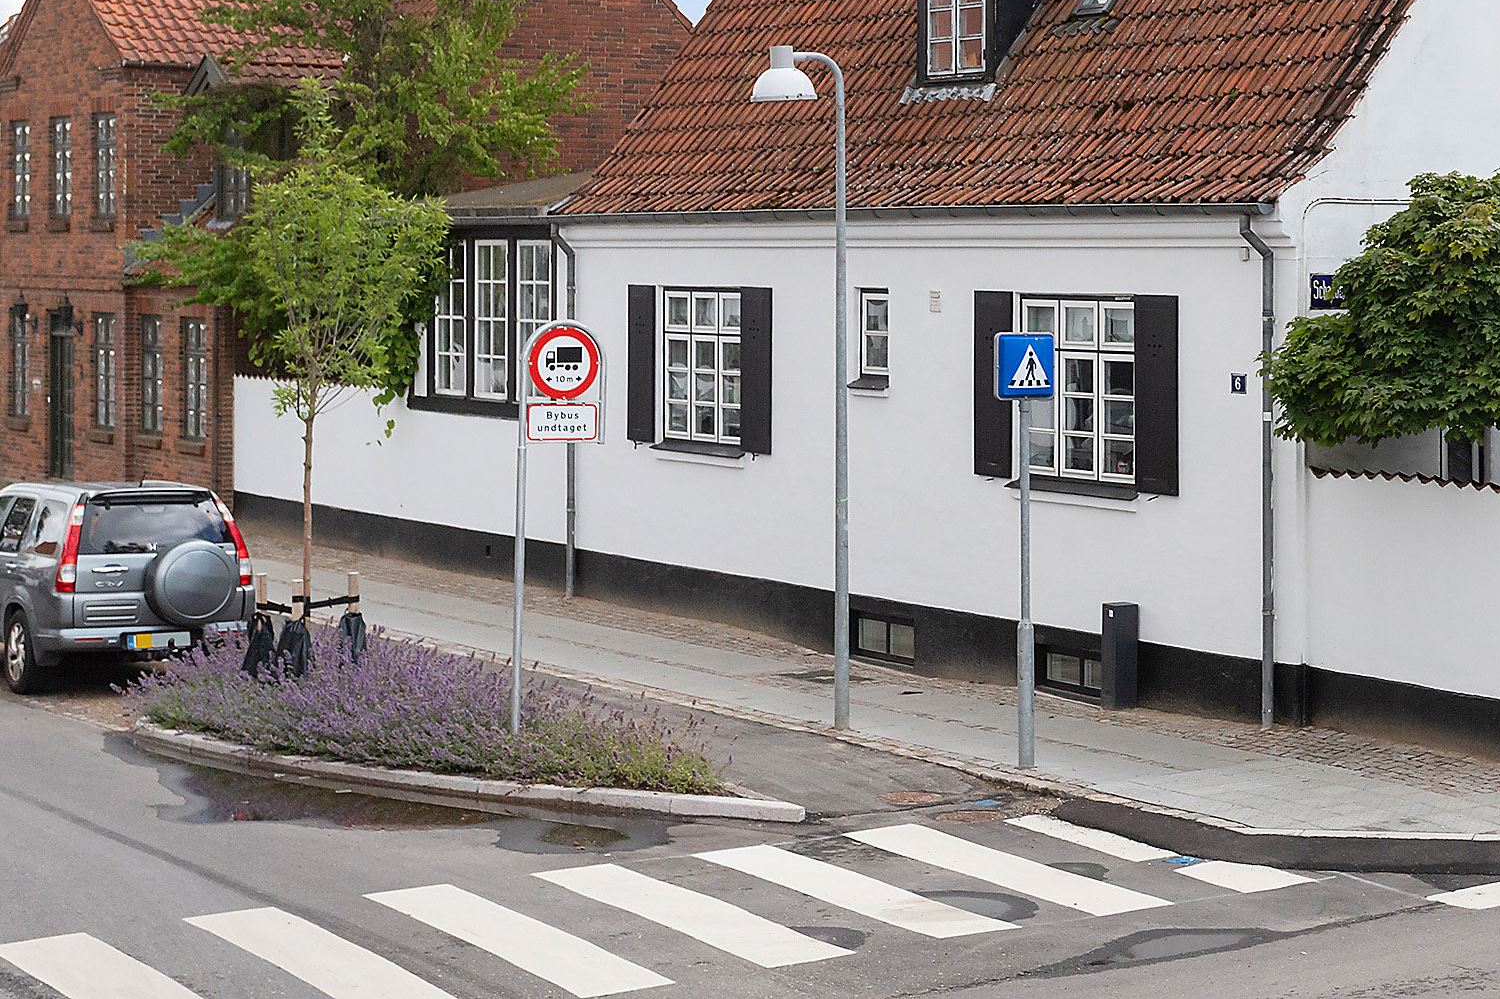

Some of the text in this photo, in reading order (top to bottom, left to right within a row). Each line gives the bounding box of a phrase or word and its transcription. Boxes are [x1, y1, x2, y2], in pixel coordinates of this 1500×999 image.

[1234, 376, 1241, 391] 6
[546, 411, 579, 421] Bybus
[537, 423, 587, 433] undtaget
